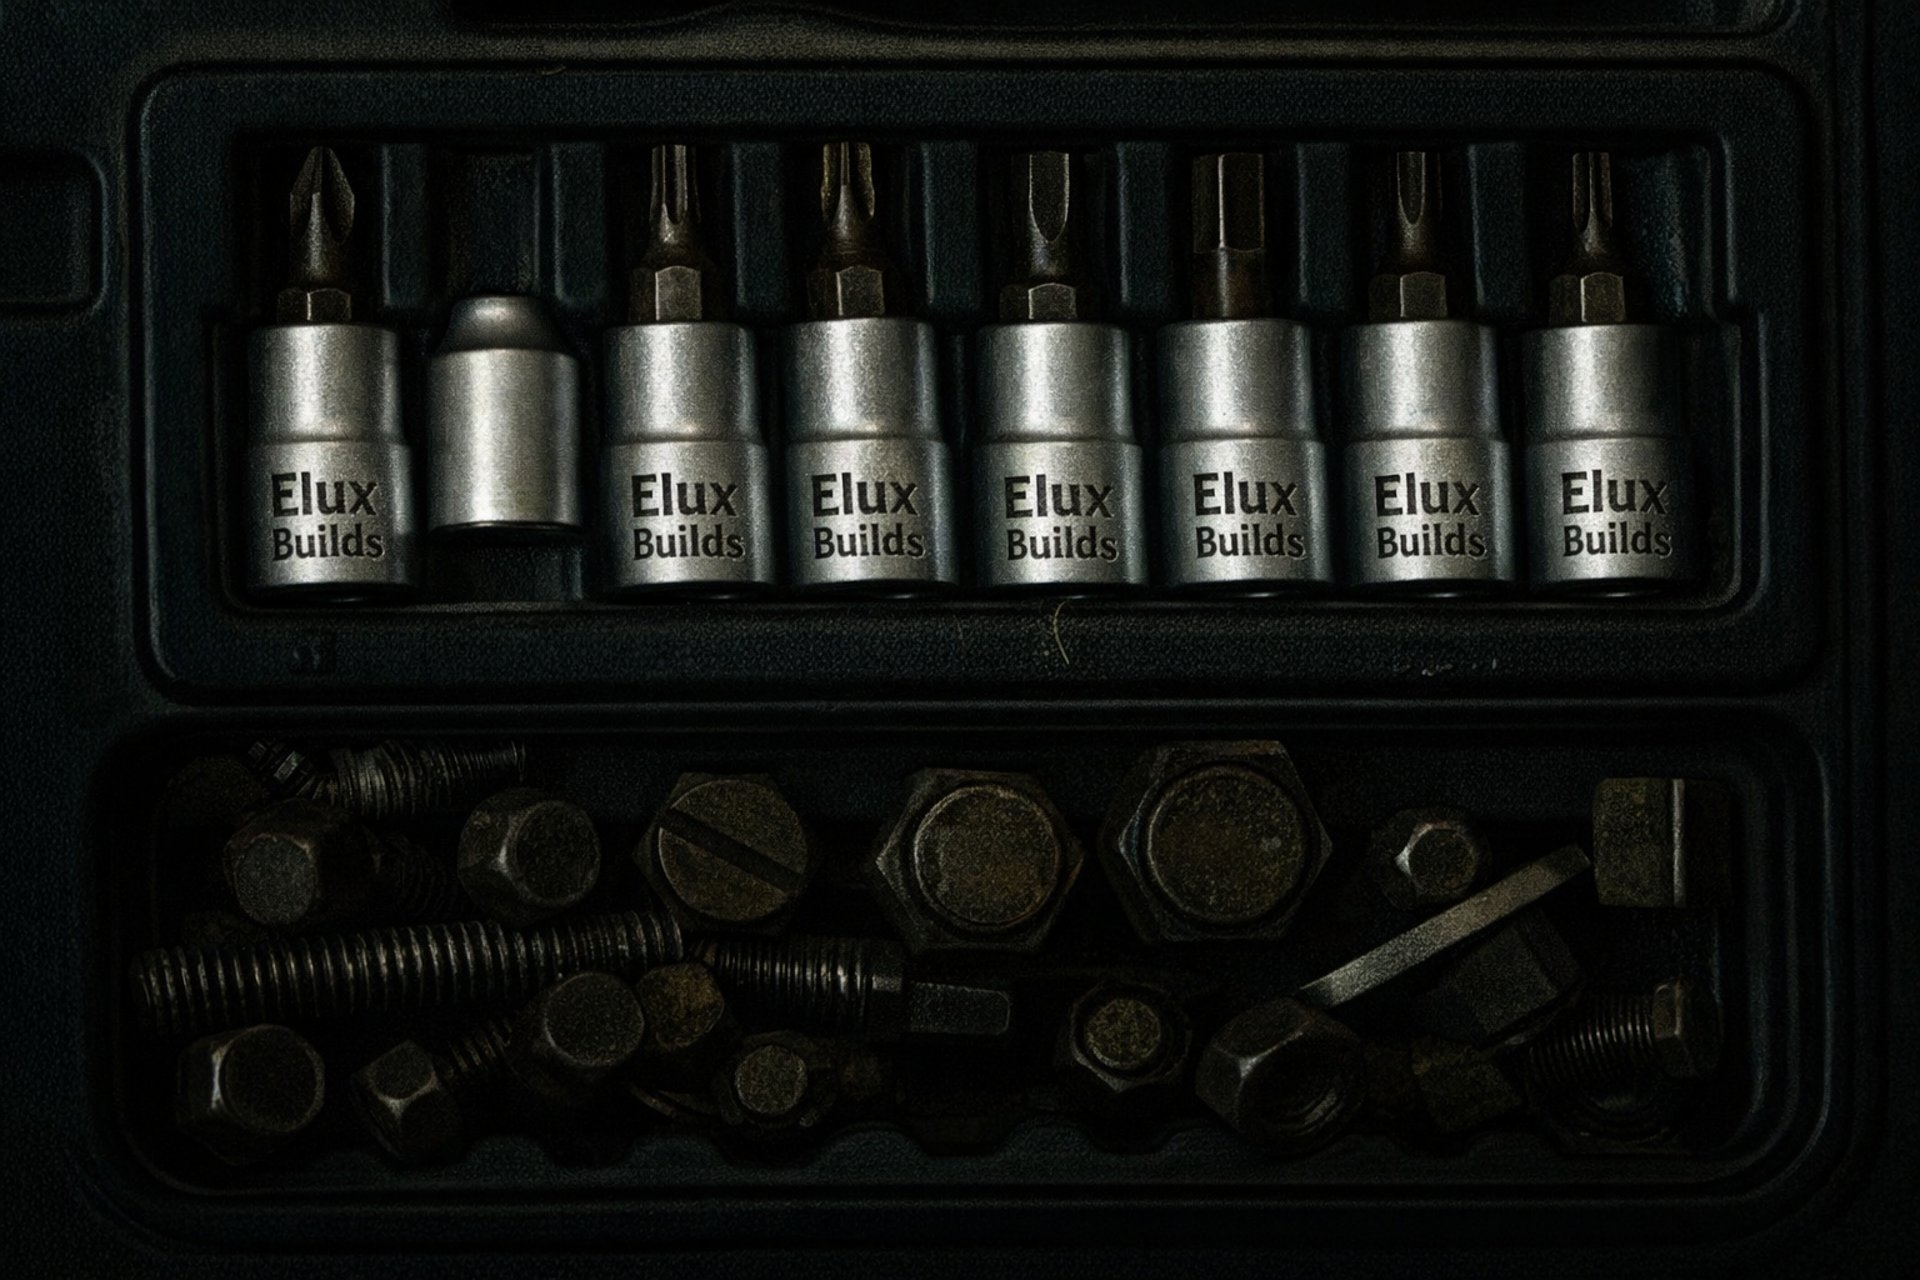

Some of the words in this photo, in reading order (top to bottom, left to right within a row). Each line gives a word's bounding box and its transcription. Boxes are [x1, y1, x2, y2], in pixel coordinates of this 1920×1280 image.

[271, 471, 379, 518] Elux
[631, 472, 739, 518] Elux
[811, 472, 919, 517] Elux
[1004, 473, 1115, 519] Elux
[1193, 471, 1298, 517] Elux
[1374, 472, 1480, 517] Elux
[1561, 469, 1669, 515] Elux
[271, 523, 385, 562] Builds
[633, 523, 746, 561] Builds
[813, 523, 925, 560] Builds
[1006, 525, 1119, 562] Builds
[1195, 523, 1306, 559] Builds
[1376, 522, 1487, 560] Builds
[1563, 521, 1673, 558] Builds
